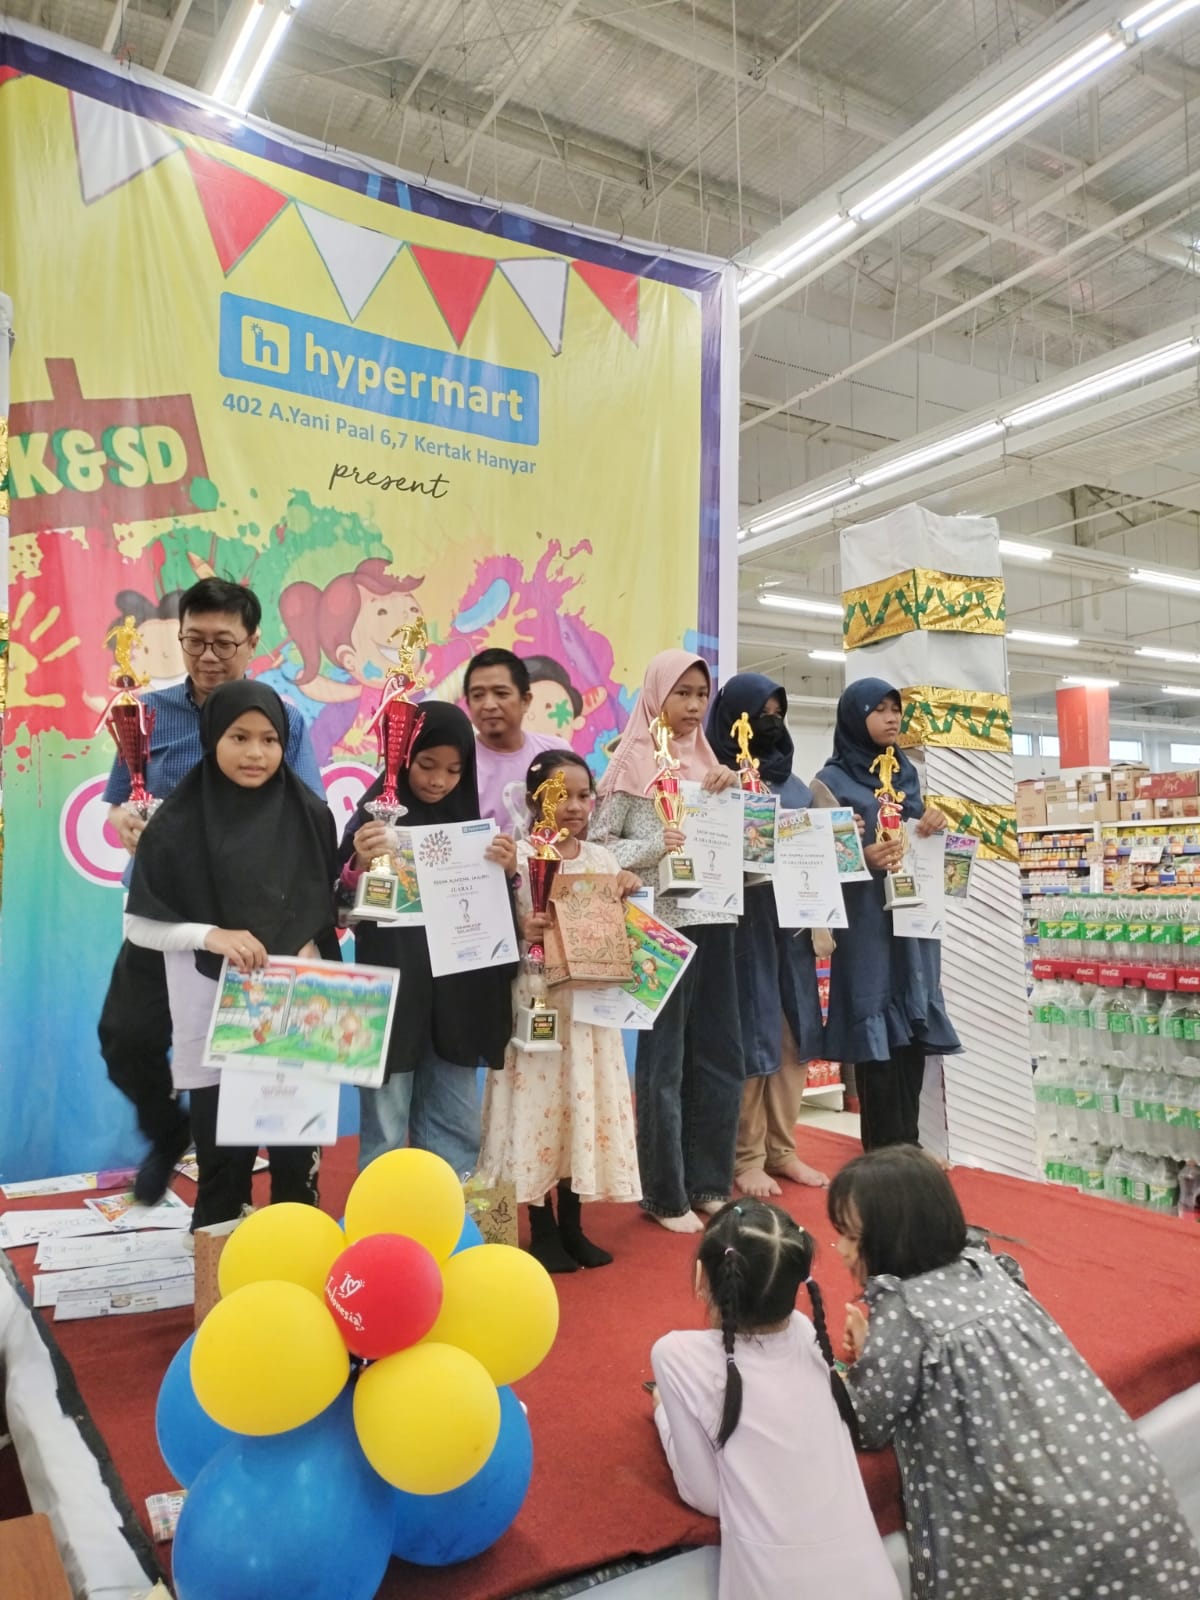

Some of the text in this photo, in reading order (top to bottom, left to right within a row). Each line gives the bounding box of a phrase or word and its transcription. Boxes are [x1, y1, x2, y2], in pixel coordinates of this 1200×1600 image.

[305, 332, 524, 422] hypermart
[222, 393, 537, 475] 402 A.Yani Paal 6,7 Kertak Hanyar
[328, 463, 450, 499] present
